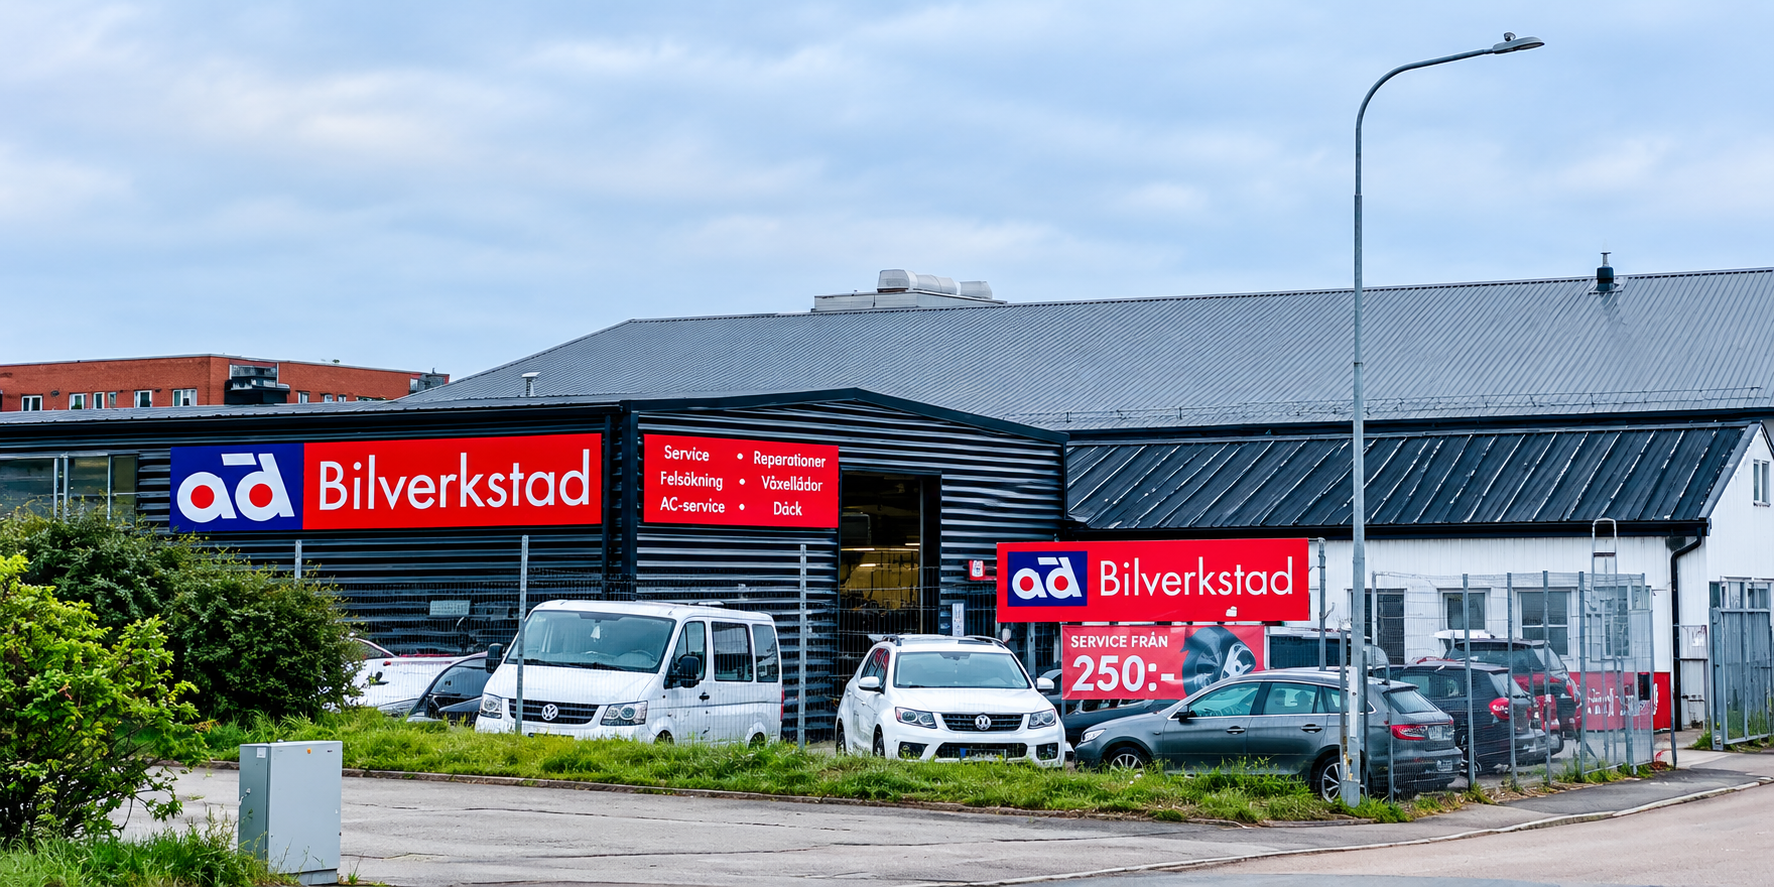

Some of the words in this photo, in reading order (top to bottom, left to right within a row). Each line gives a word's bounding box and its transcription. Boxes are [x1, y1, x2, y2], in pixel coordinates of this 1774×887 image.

[665, 445, 709, 461] Service
[754, 451, 826, 468] Reparationer
[320, 449, 589, 510] Bilverkstad
[661, 471, 723, 491] Felsökning
[660, 497, 725, 513] AC-service
[1101, 556, 1292, 596] Bilverkstad
[1071, 635, 1127, 648] SERVICE
[1132, 631, 1167, 648] FRÅN
[1072, 655, 1175, 691] 250:-
